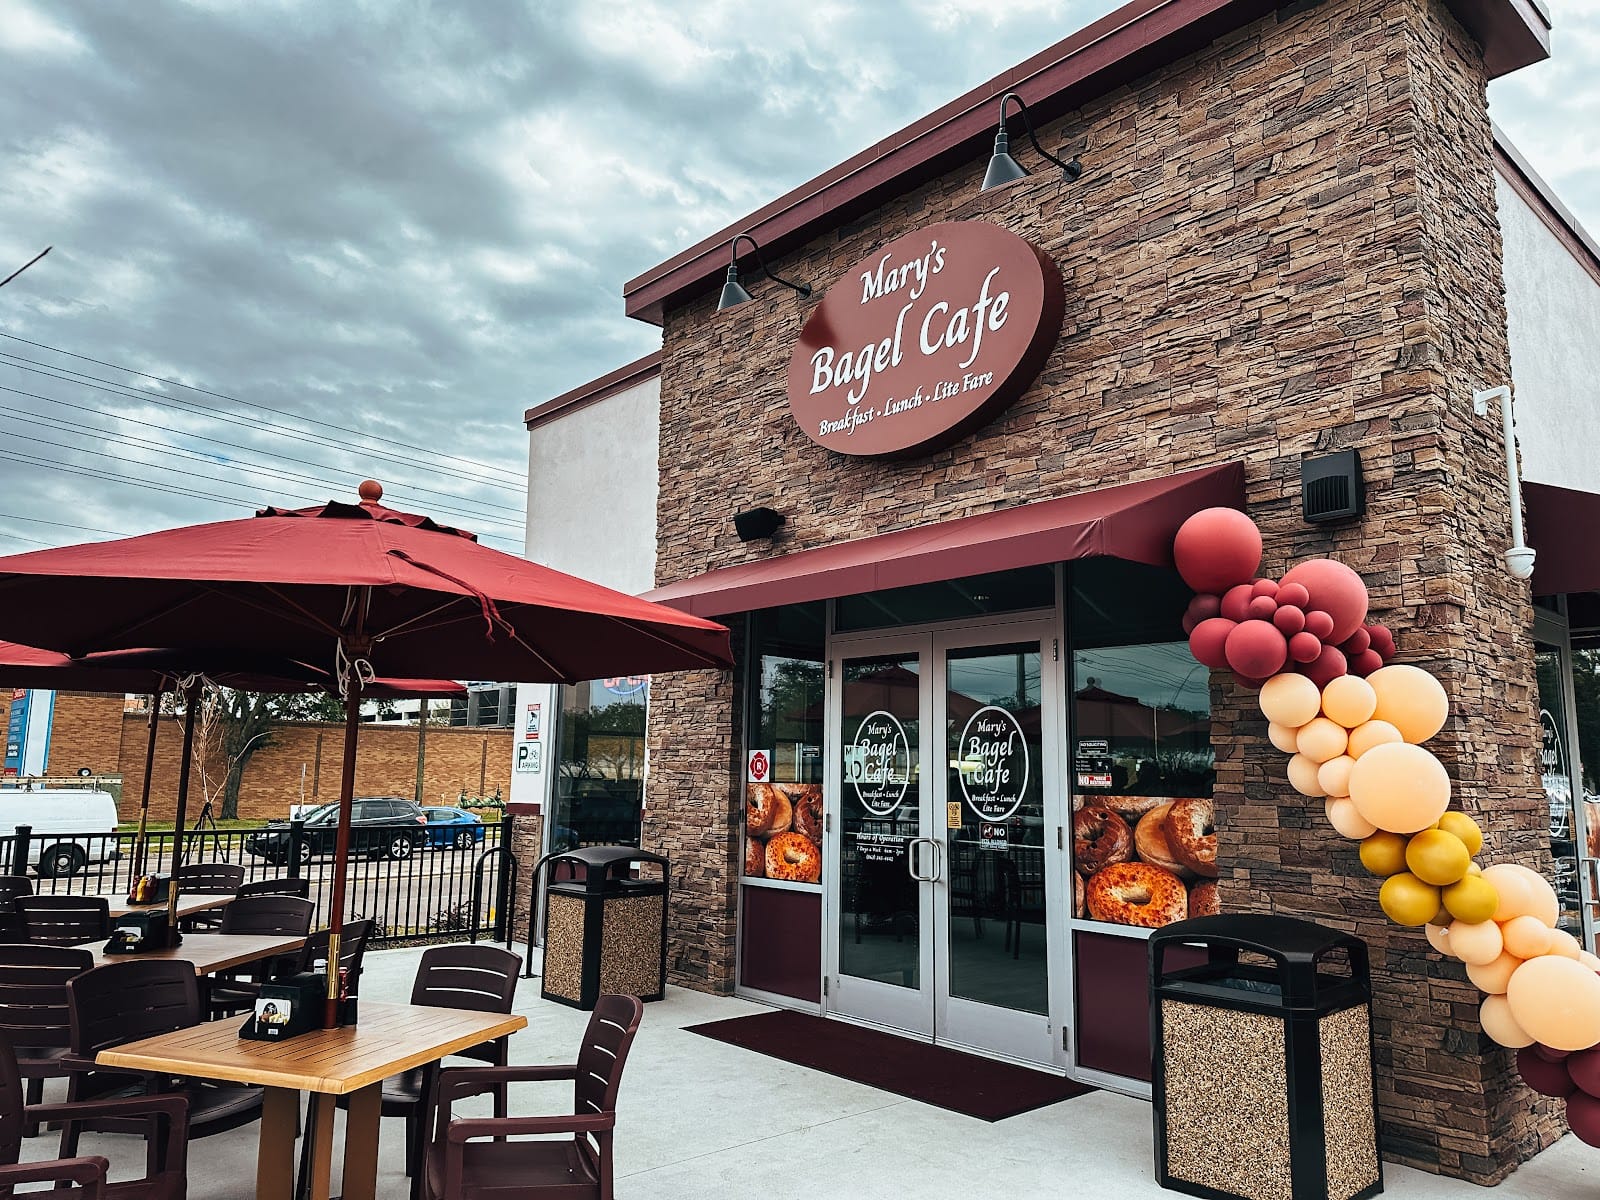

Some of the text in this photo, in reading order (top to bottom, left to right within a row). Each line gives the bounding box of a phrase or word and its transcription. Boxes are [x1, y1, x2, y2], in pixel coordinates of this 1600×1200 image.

[860, 240, 946, 304] Mary's
[809, 266, 1010, 405] Bagel Cafe
[819, 371, 993, 435] Breakfast Lunch Lite Fare
[868, 722, 892, 739] Mary's
[977, 718, 1007, 737] Mary's
[860, 732, 900, 766] Bagel
[968, 730, 1017, 767] Bagel
[865, 758, 894, 791] Cafe
[974, 757, 1010, 794] Cafe
[1079, 776, 1089, 785] NO
[863, 789, 899, 801] Breakfast Lunch
[972, 793, 1016, 804] Breakfast Lunch
[982, 804, 993, 812] Lite
[879, 835, 904, 844] Operation
[993, 827, 1005, 837] NO
